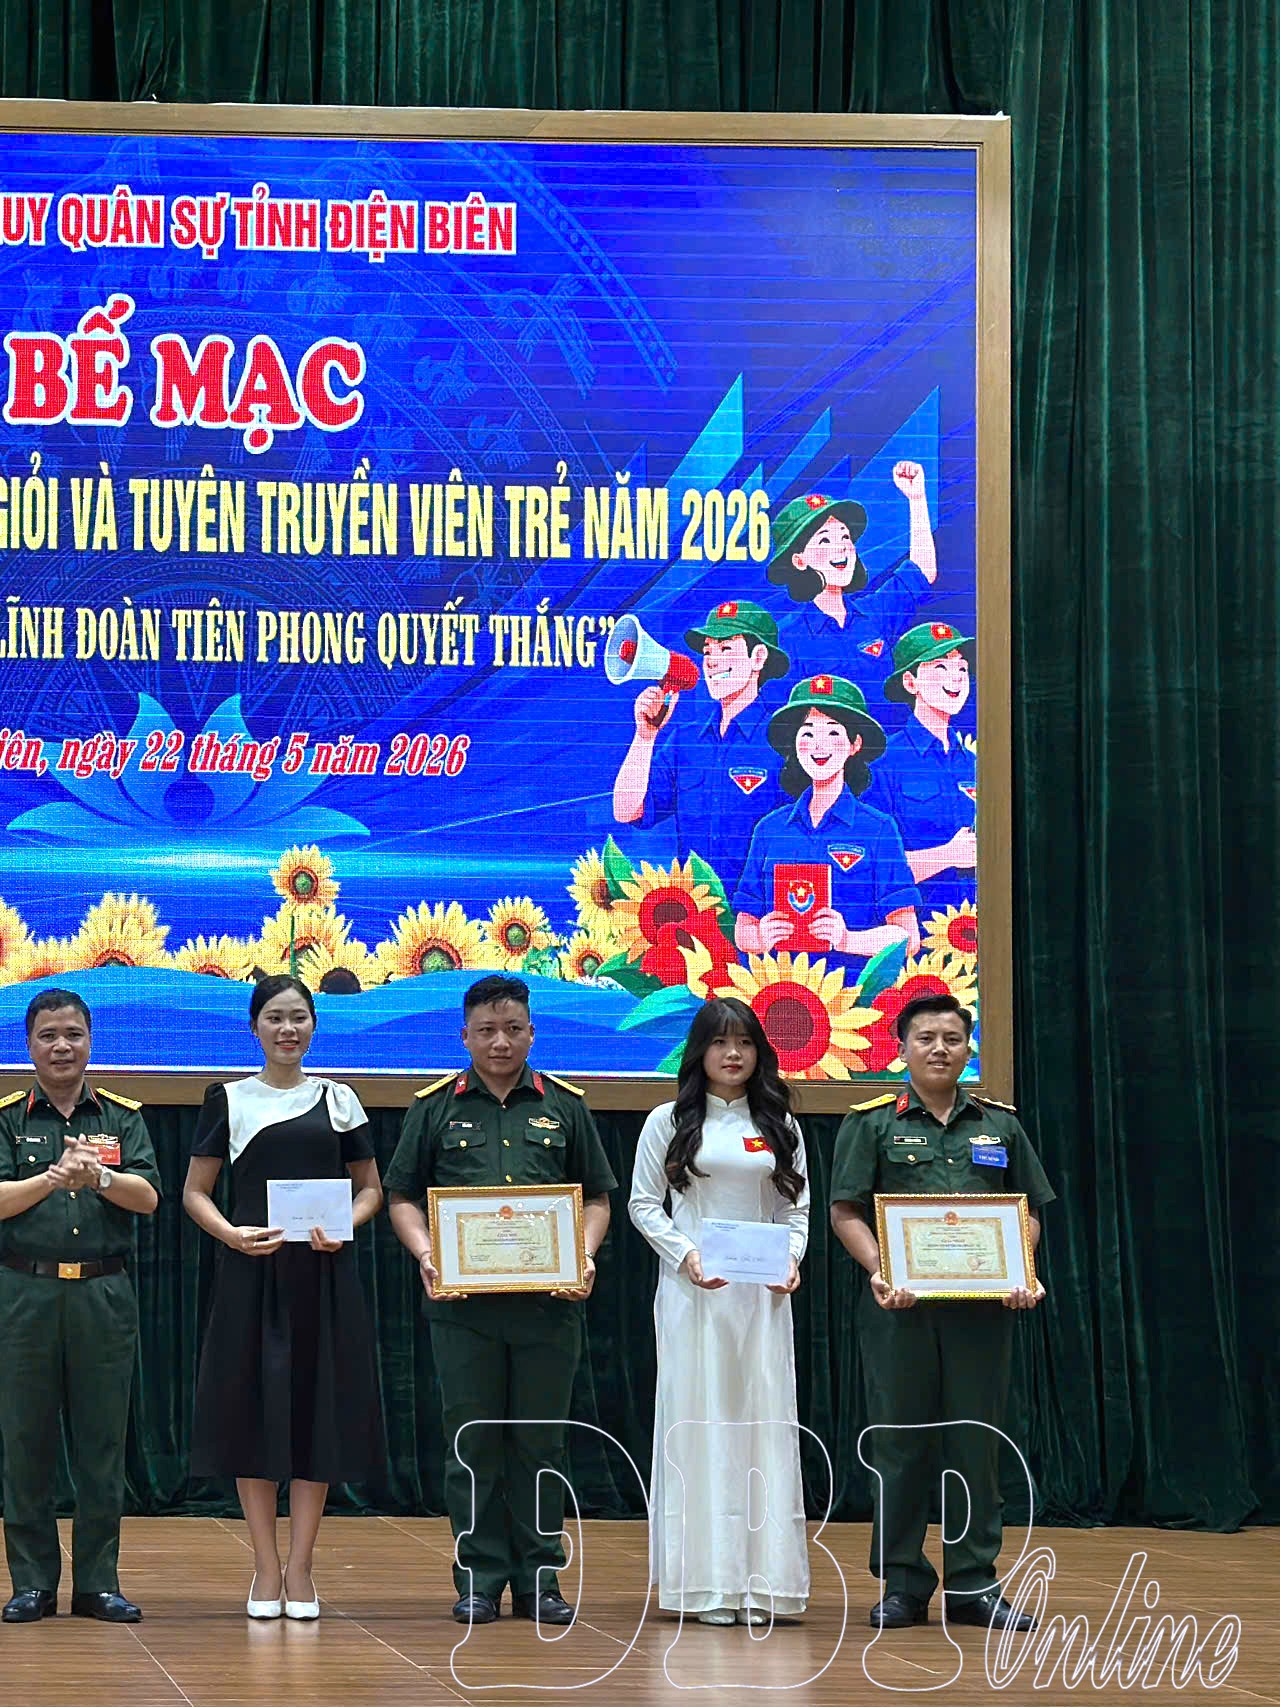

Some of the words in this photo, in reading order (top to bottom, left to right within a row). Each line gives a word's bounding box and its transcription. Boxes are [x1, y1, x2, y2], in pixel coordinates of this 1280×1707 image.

[57, 185, 164, 252] QUÂN
[170, 192, 232, 259] SỰ
[231, 182, 320, 251] TỈNH
[325, 190, 418, 262] ĐIỆN
[424, 192, 516, 255] BIÊN
[3, 293, 135, 427] BẾ
[150, 333, 366, 454] MẠC
[71, 462, 117, 550] VÀ
[129, 464, 245, 552] TUYÊN
[257, 456, 397, 555] TRUYỀN
[410, 468, 493, 556] VIÊN
[505, 461, 570, 558] TRẺ
[584, 472, 668, 559] NĂM
[681, 489, 770, 561] 2026
[76, 597, 161, 660] ĐOÀN
[172, 597, 245, 661] TIÊN
[257, 611, 366, 664] PHONG
[378, 597, 479, 669] QUYẾT
[489, 598, 617, 668] THẮNG”
[58, 733, 137, 778] ngày
[141, 731, 184, 772] 22
[189, 732, 280, 780] tháng
[282, 734, 308, 774] 5
[311, 735, 380, 775] năm
[386, 734, 469, 776] 2026
